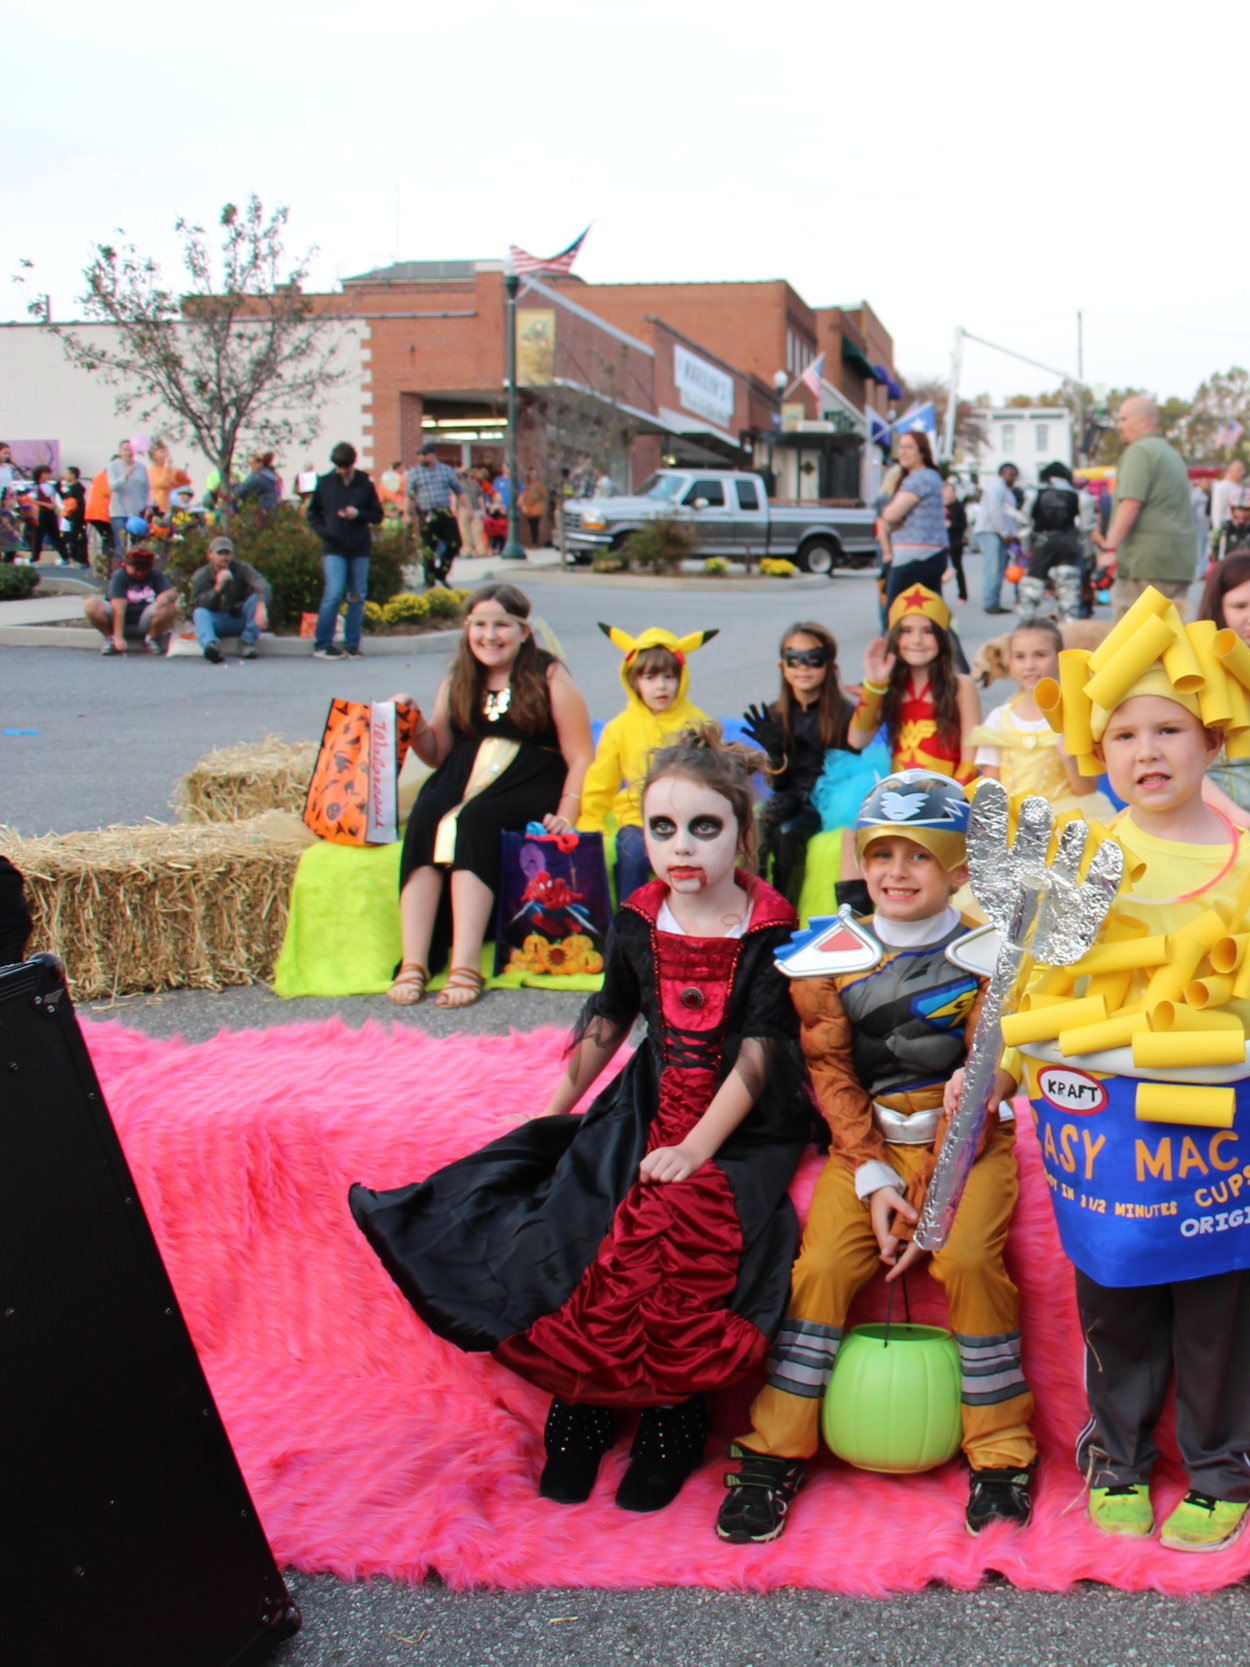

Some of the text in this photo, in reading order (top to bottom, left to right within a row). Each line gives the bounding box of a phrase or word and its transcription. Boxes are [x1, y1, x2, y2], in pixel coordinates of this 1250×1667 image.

[1047, 1079, 1098, 1102] KRAFT
[1034, 1108, 1240, 1182] ASY MAC
[1061, 1183, 1075, 1200] IN
[1114, 1201, 1178, 1219] MINUTES
